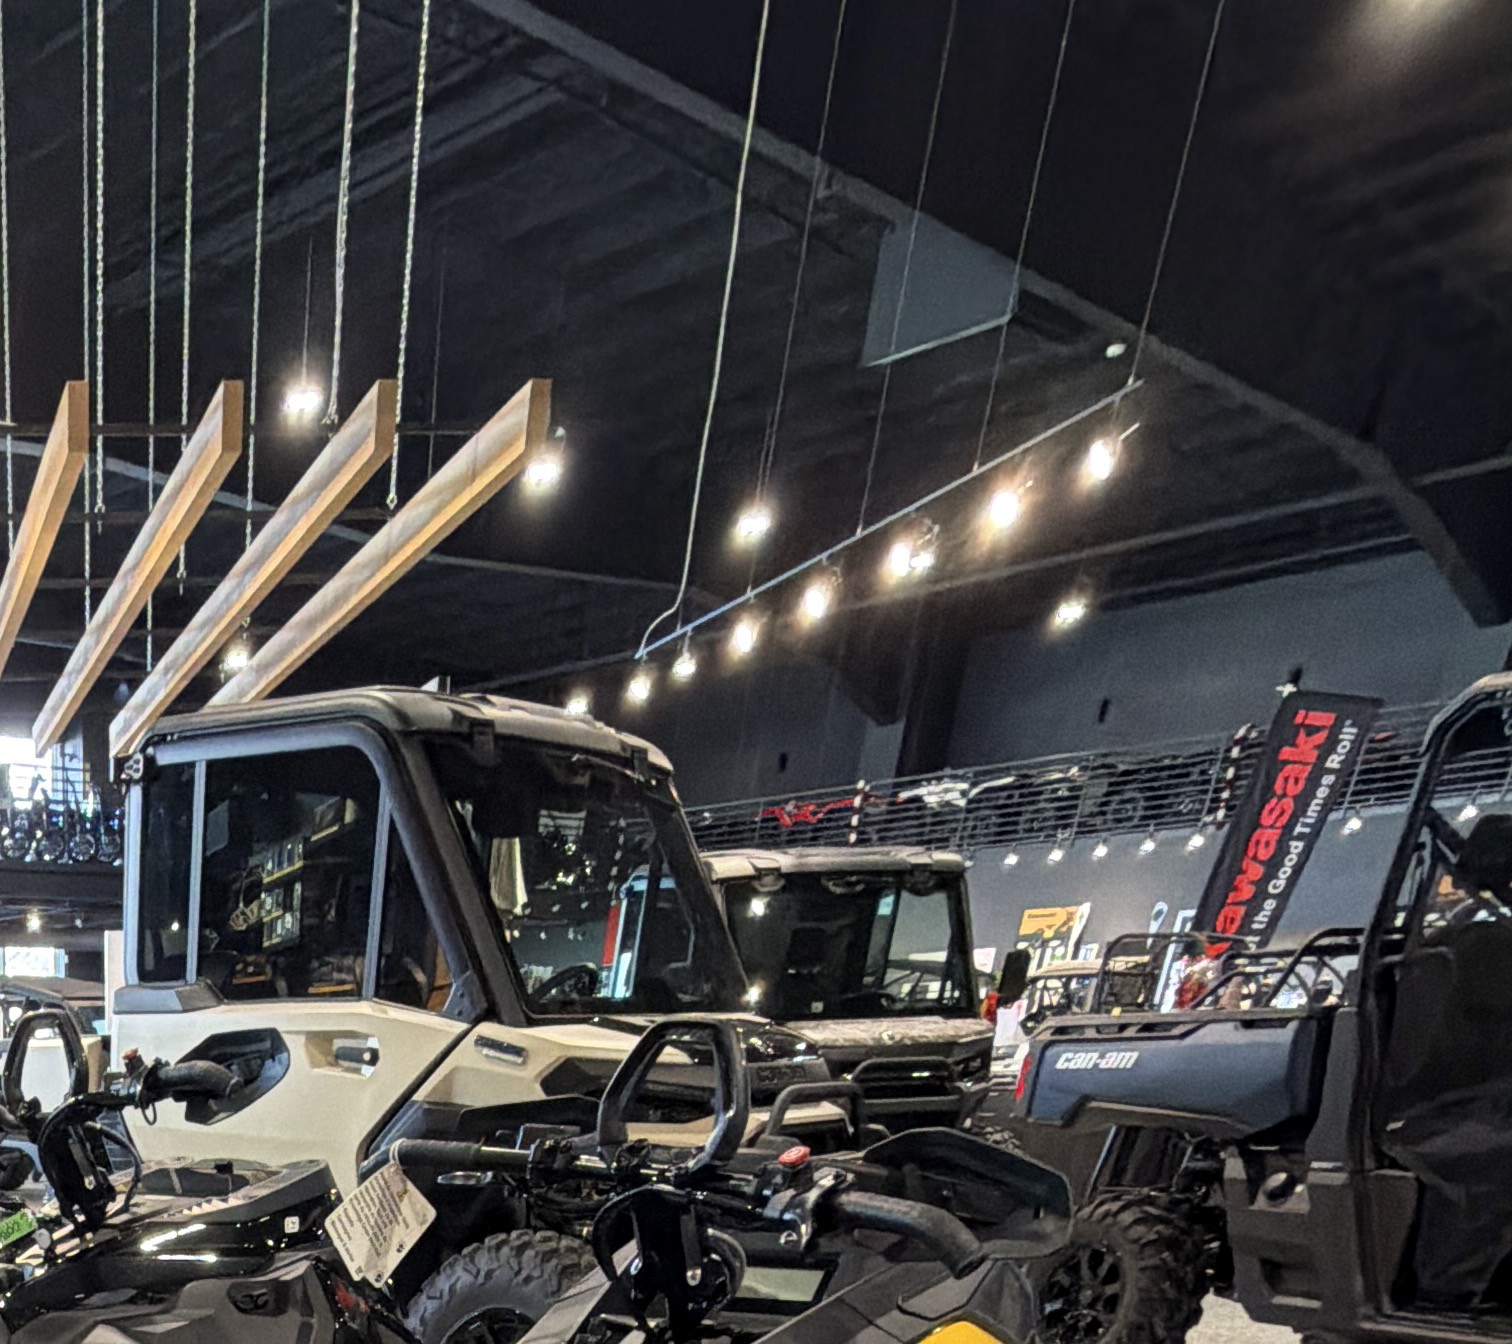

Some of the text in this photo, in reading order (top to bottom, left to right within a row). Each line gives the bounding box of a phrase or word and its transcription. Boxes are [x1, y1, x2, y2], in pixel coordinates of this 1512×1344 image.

[1251, 898, 1277, 930] the
[1268, 840, 1305, 894] Good
[1293, 773, 1336, 837] Times
[1055, 1051, 1139, 1069] can-am
